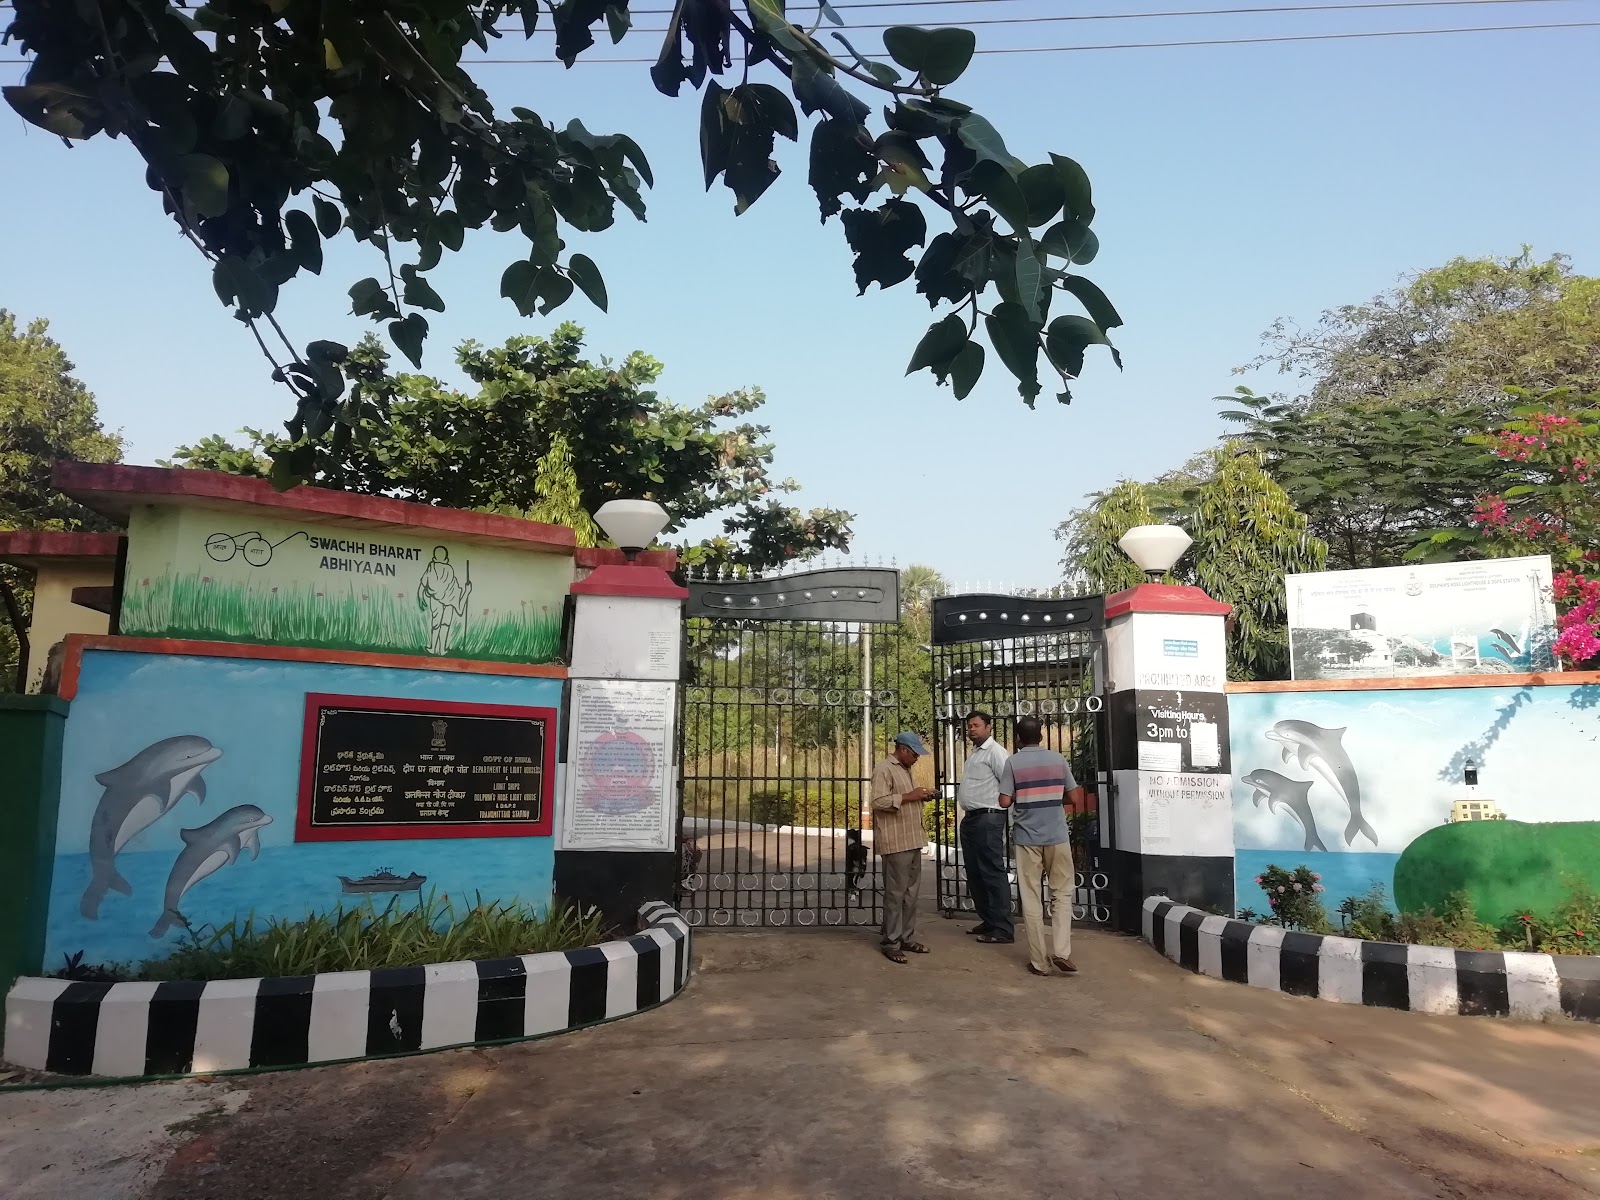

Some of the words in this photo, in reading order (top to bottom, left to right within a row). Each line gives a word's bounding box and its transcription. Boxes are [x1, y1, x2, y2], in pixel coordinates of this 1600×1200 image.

[309, 536, 366, 555] SWACHH
[368, 543, 422, 561] BHARAT
[319, 556, 396, 577] ABHIYAAN
[1194, 674, 1217, 687] AREA
[1151, 710, 1181, 722] Visiting
[1182, 710, 1204, 722] Hours
[1147, 723, 1173, 741] 3pm
[1176, 724, 1188, 738] to
[402, 763, 415, 774] दीप
[417, 765, 426, 773] घर
[428, 765, 442, 773] तथा
[443, 764, 454, 775] दीप
[456, 765, 470, 774] पोत
[472, 765, 501, 774] DEPARTMENT
[503, 766, 508, 774] OF
[426, 779, 445, 787] विभाग
[1149, 776, 1163, 785] NO
[1166, 776, 1219, 788] ADMISSION
[433, 789, 446, 798] नोज
[474, 793, 496, 801] DOLPHIN'S
[1147, 789, 1179, 798] WITHOUT
[1182, 790, 1225, 800] PERMISSION
